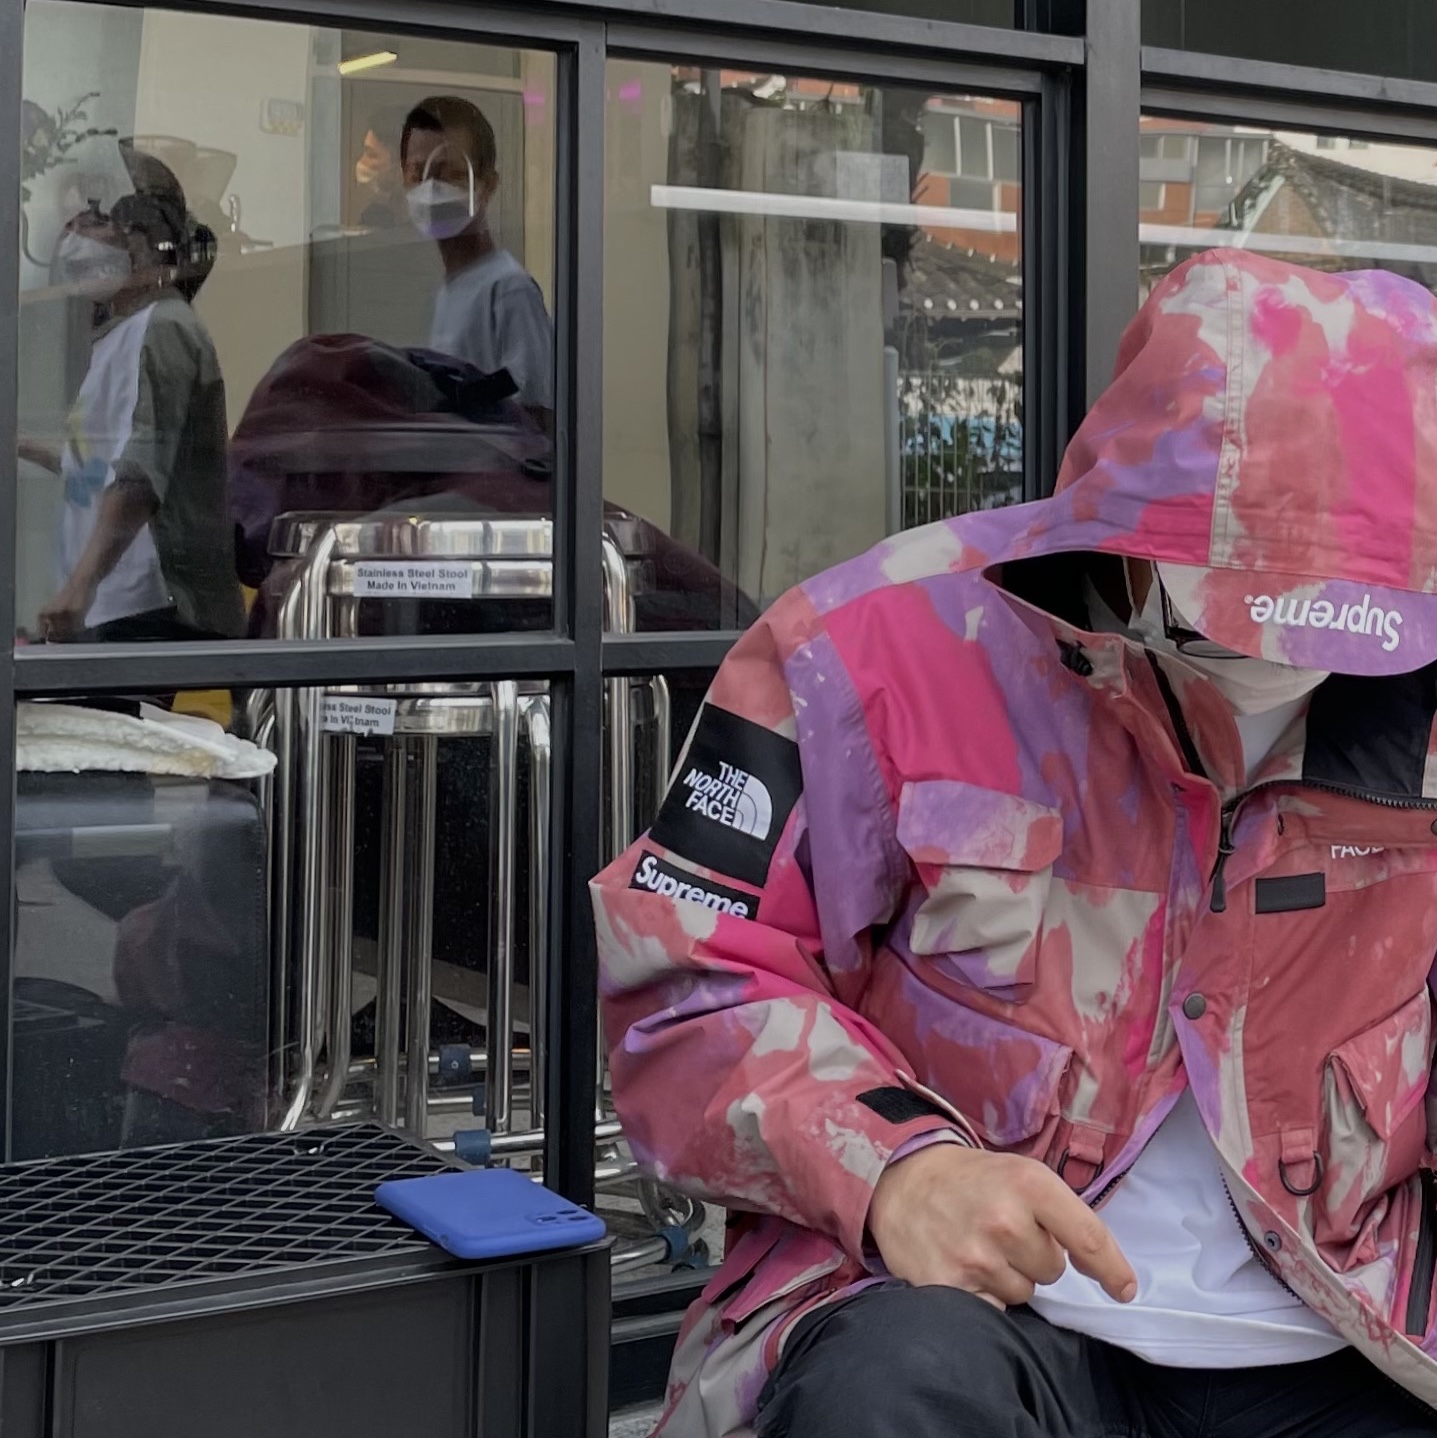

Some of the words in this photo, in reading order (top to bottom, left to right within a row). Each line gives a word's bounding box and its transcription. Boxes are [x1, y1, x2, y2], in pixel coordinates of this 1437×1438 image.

[357, 568, 404, 578] Stainless
[407, 568, 435, 578] Steel
[438, 569, 468, 579] Stool
[367, 580, 394, 590] Made
[397, 580, 407, 590] In
[410, 581, 456, 591] Vietnam
[1250, 594, 1404, 652] Supreme
[339, 703, 362, 713] Steel
[364, 704, 391, 715] Stool
[683, 767, 742, 808] NORTH
[718, 760, 750, 791] THE
[685, 791, 736, 827] FACE
[635, 855, 749, 918] Supreme
